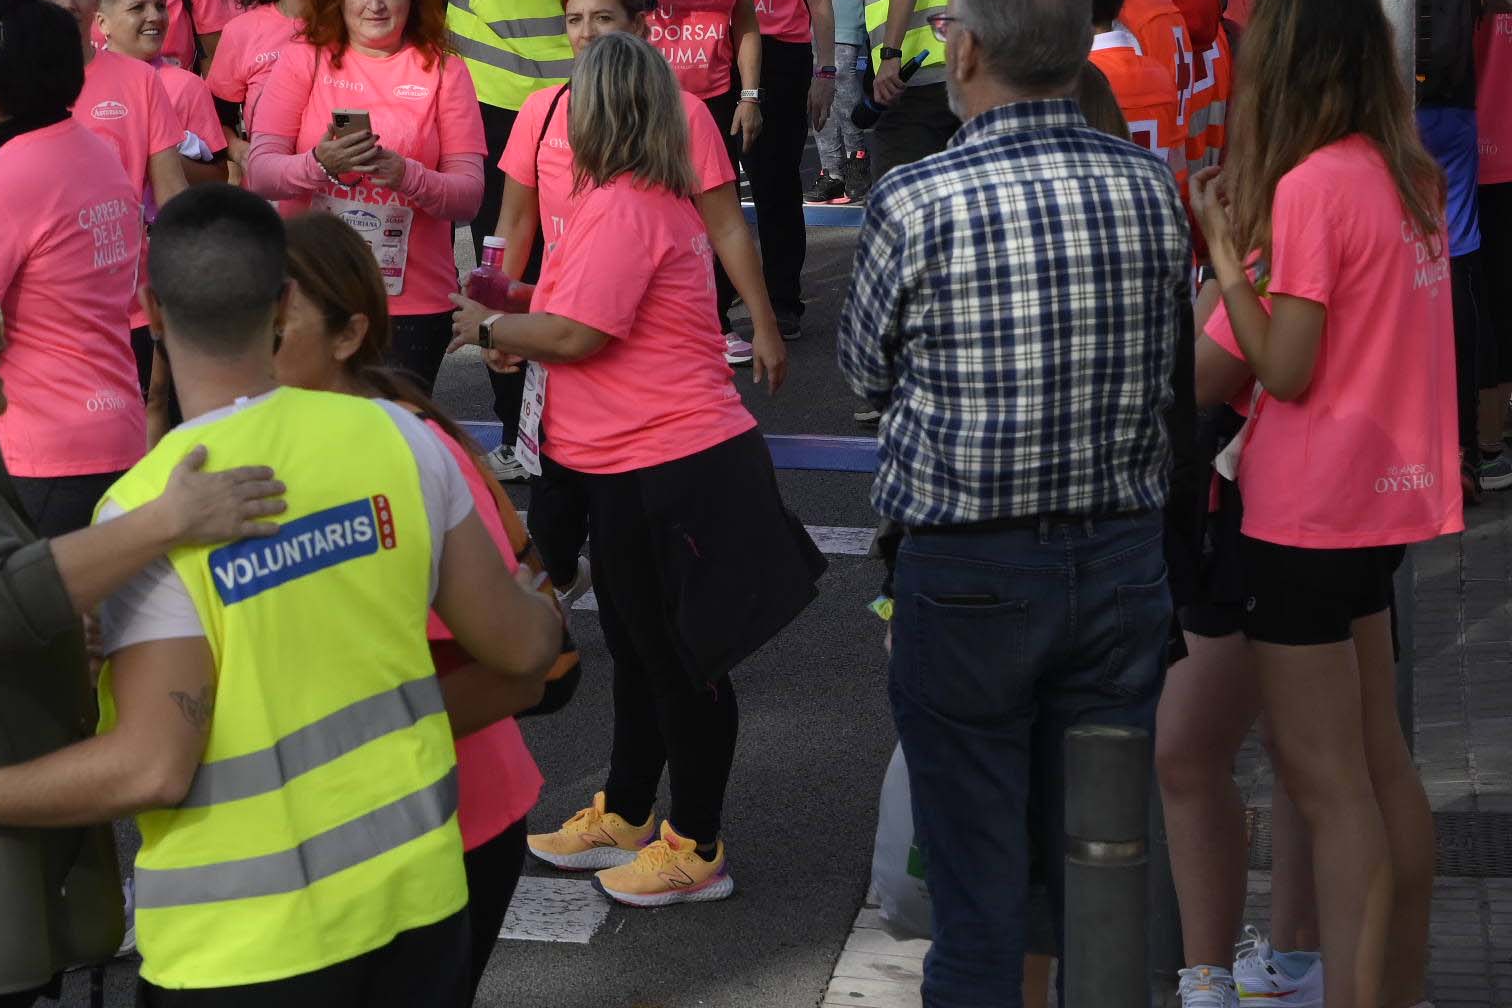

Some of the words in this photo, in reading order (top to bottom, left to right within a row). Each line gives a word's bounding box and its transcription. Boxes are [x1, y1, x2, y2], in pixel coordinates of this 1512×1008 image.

[650, 23, 725, 42] DORSAL
[78, 198, 129, 230] CARRERA
[93, 227, 108, 248] DE
[111, 223, 124, 239] LA
[93, 242, 128, 269] MUJER
[1374, 471, 1435, 494] OYSHO
[213, 515, 373, 591] VOLUNTARIS
